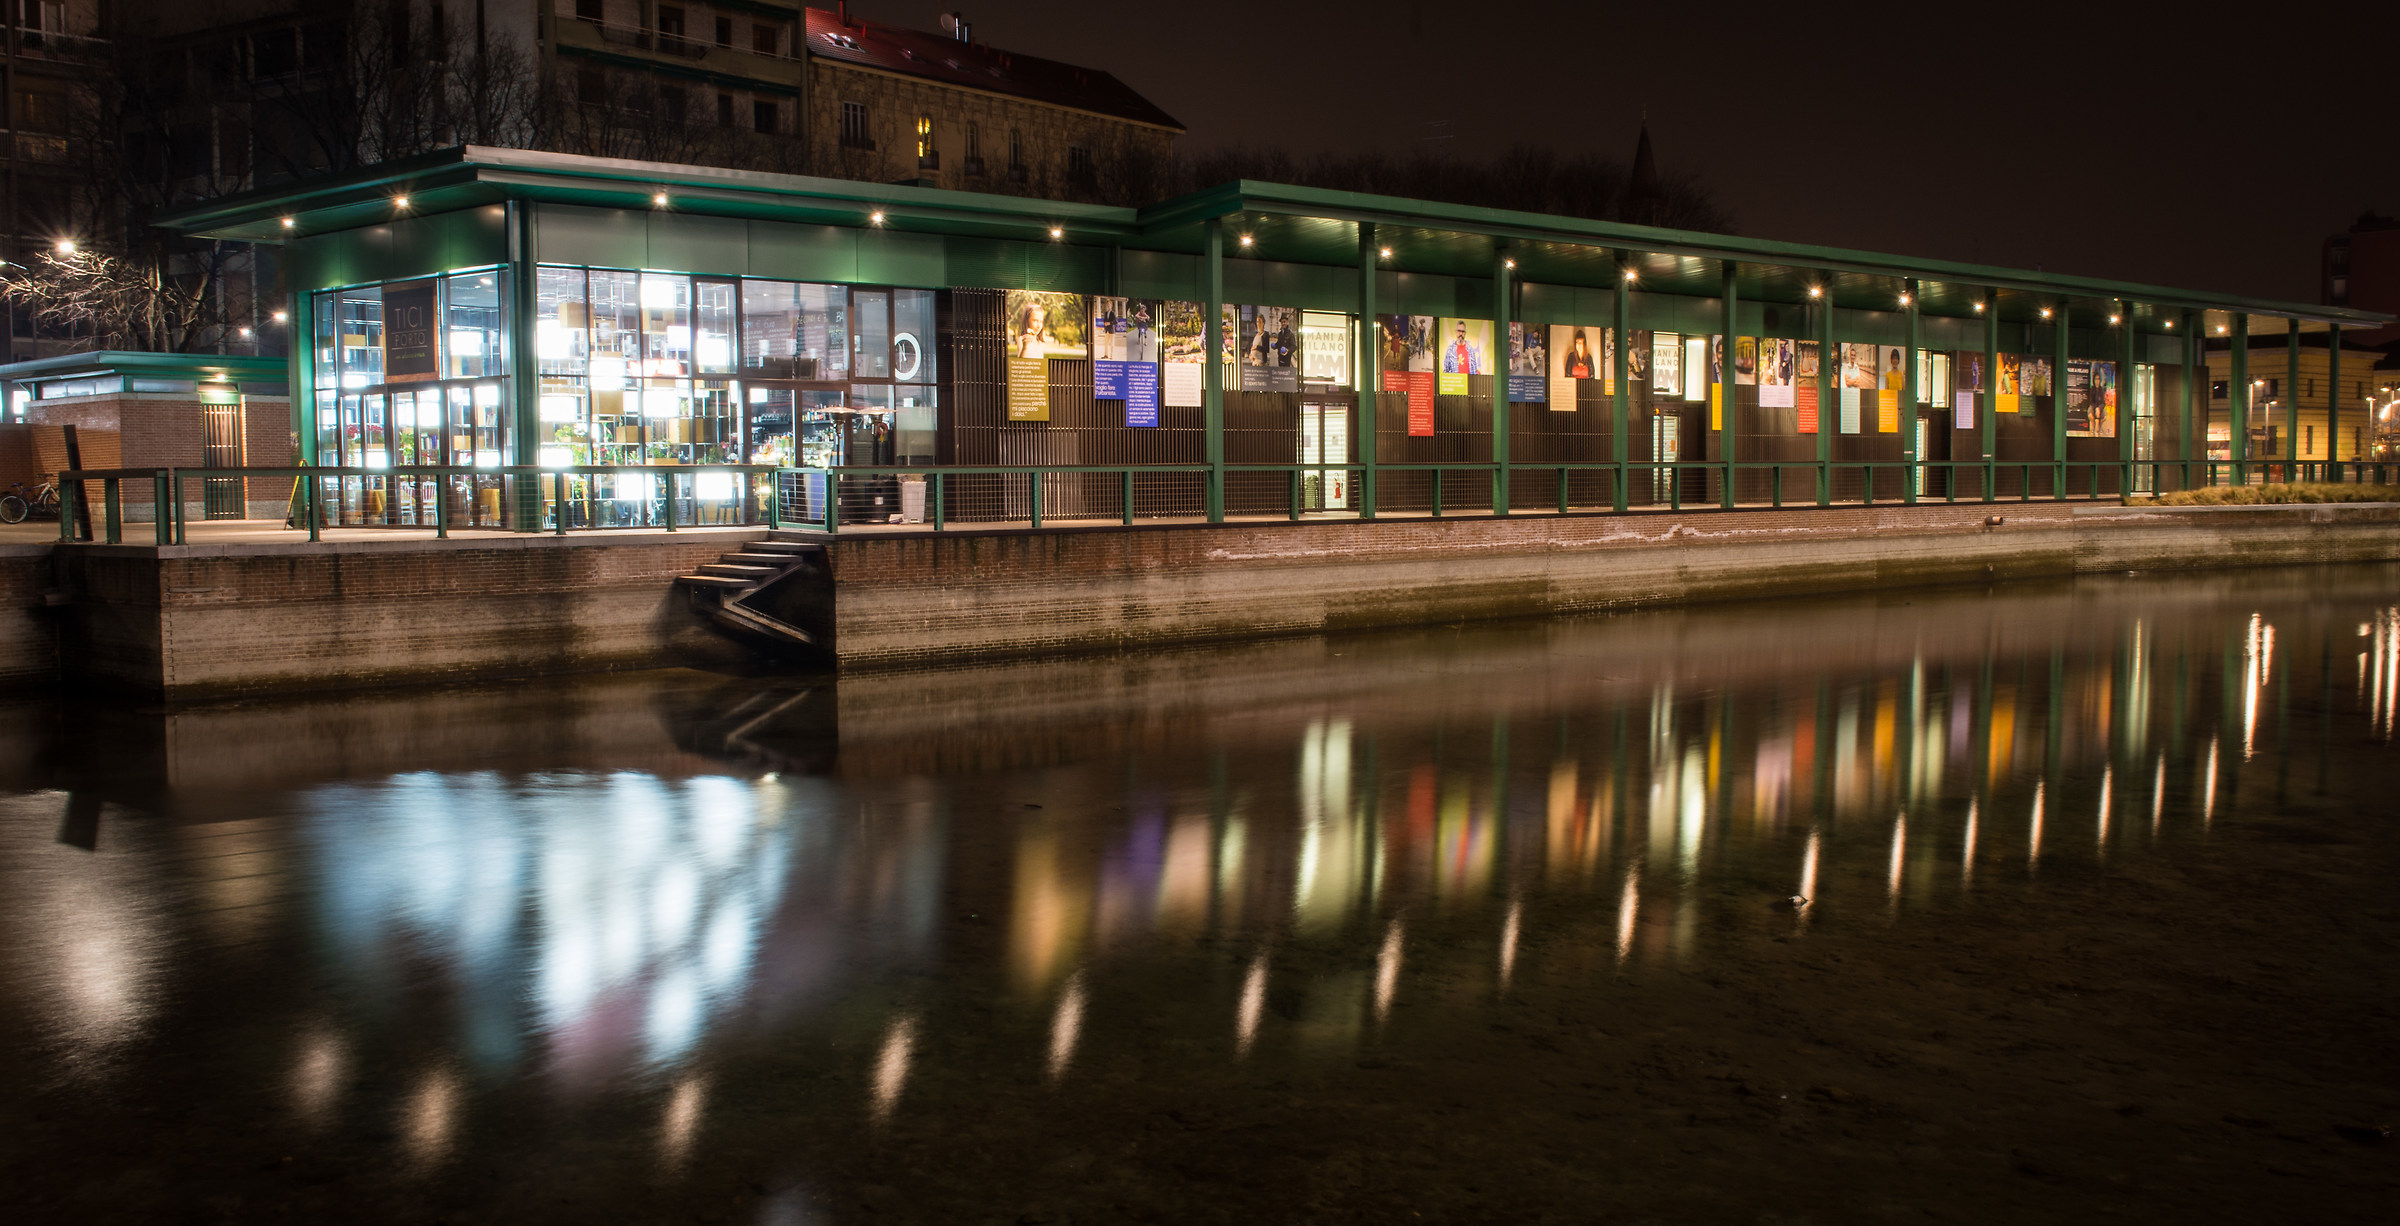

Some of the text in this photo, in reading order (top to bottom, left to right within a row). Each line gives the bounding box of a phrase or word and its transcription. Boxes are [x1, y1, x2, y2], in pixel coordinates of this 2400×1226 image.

[394, 306, 422, 328] TICI
[394, 332, 426, 347] PORTO
[1337, 333, 1345, 342] A
[1305, 354, 1345, 378] JAM
